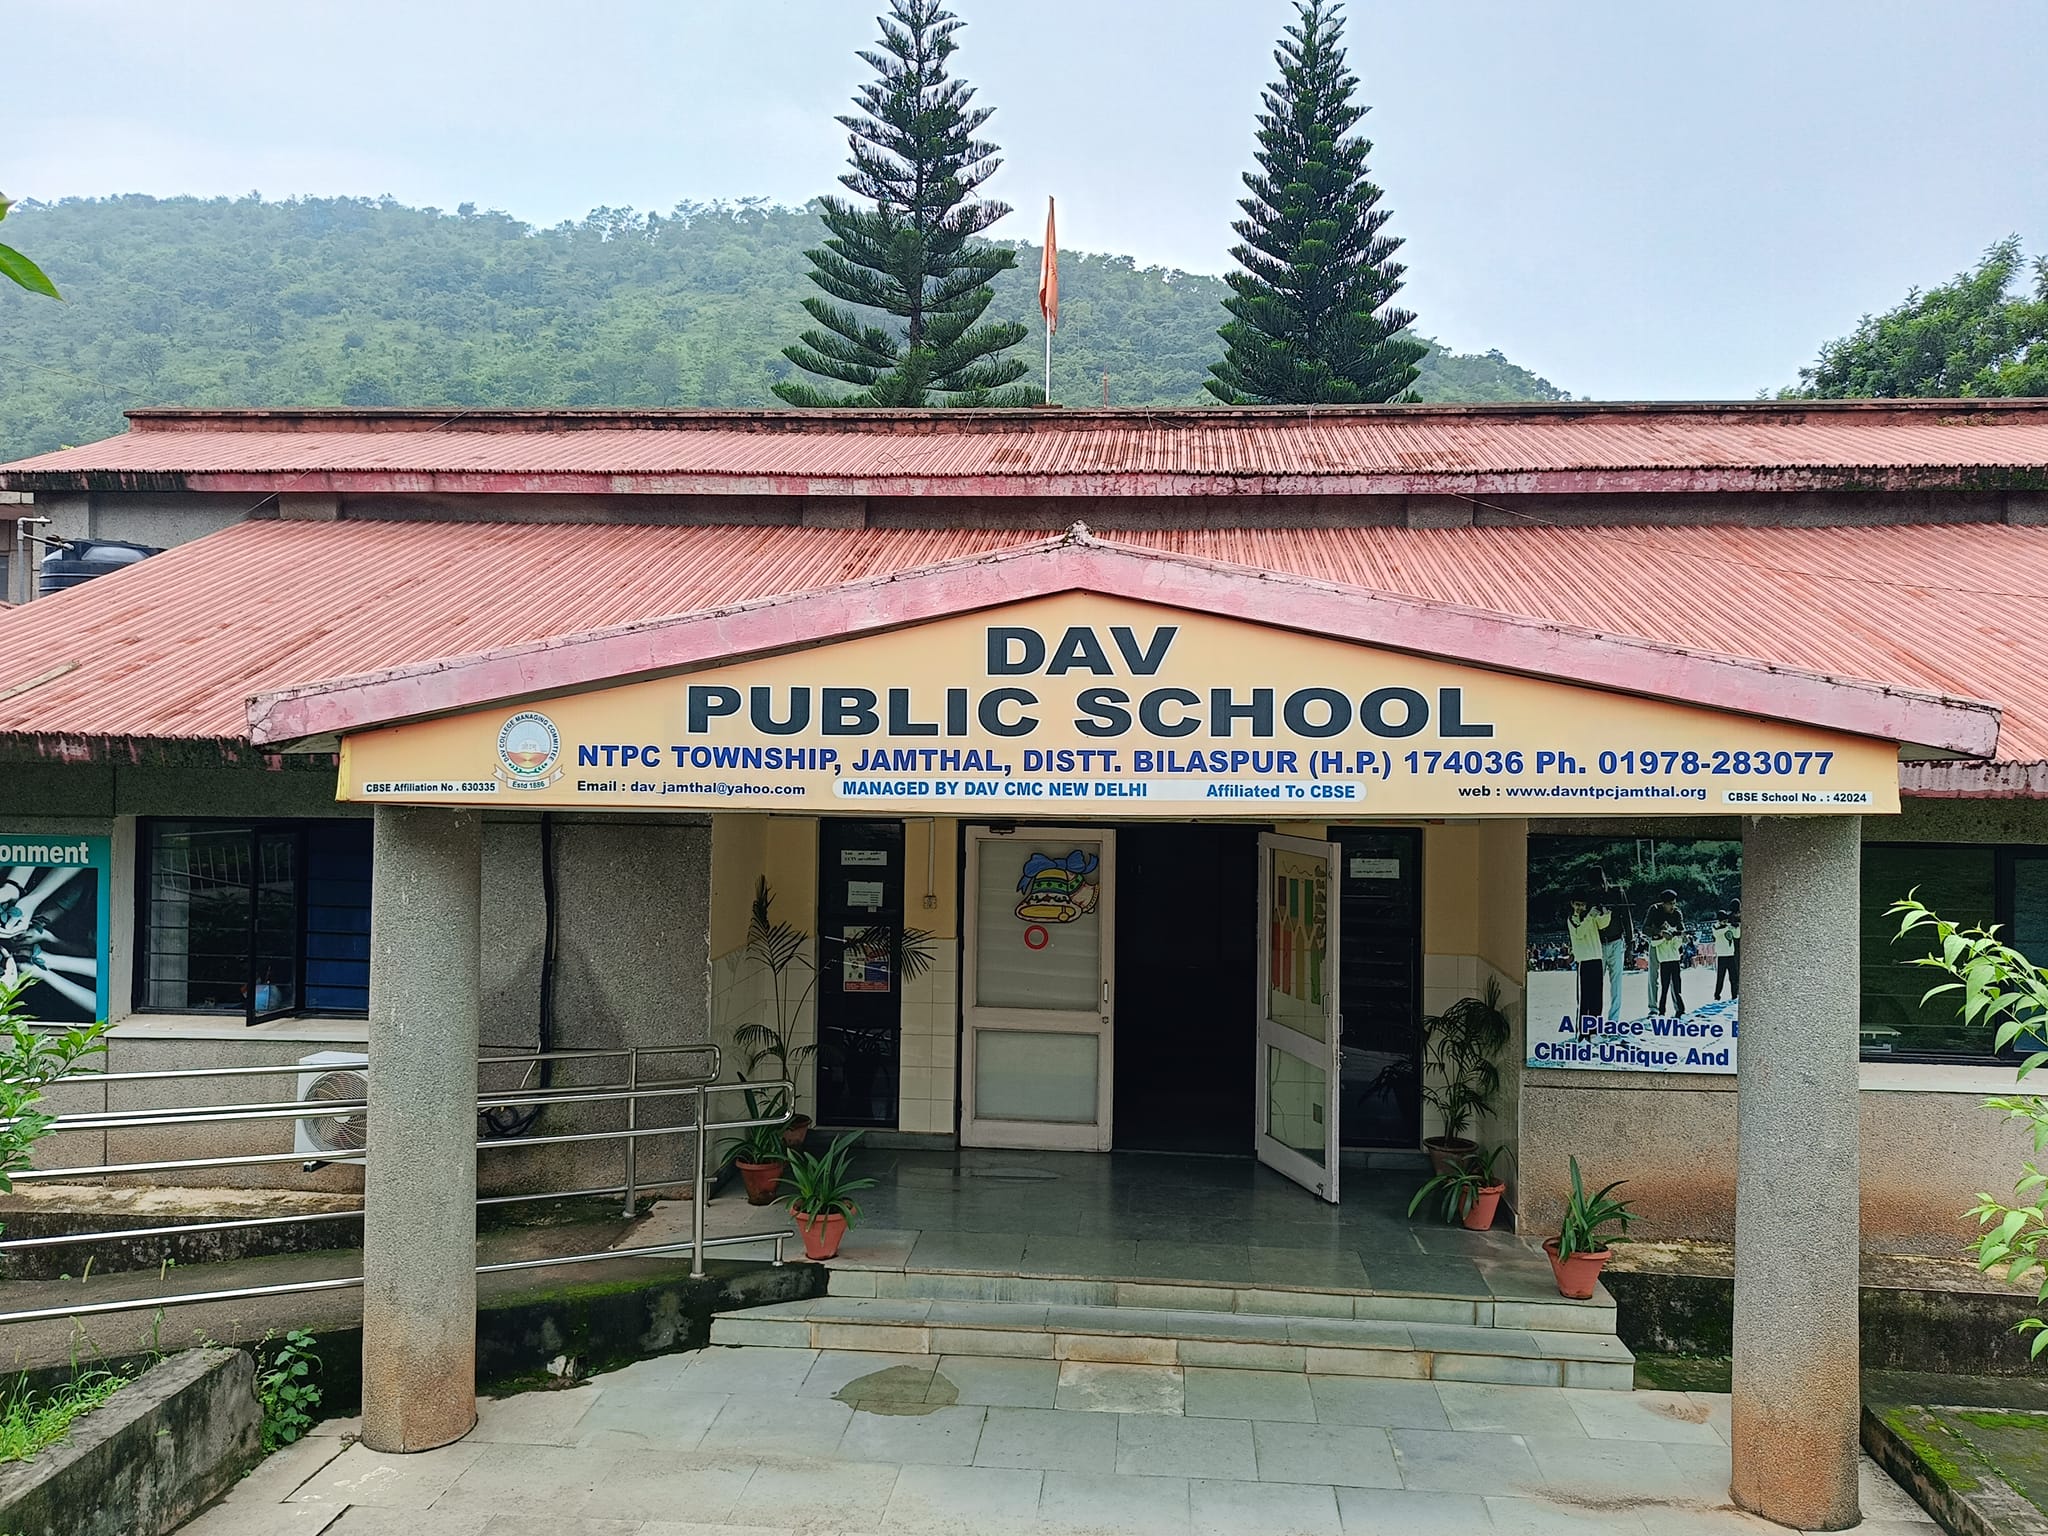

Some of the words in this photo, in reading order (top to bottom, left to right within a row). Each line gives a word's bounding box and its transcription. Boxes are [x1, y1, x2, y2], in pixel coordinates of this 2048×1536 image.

[987, 626, 1179, 676] DAV
[514, 713, 549, 726] MANAGING
[687, 685, 1041, 737] PUBLIC
[1073, 687, 1495, 738] SCHOOL
[499, 720, 516, 748] COLLEGE
[547, 724, 559, 762] COMMITTEE
[501, 749, 509, 763] DAV
[578, 745, 661, 768] NTPC
[671, 746, 841, 776] TOWNSHIP,
[852, 749, 1012, 777] JAMTHAL,
[1023, 749, 1121, 773] DISTT.
[1133, 750, 1298, 774] BILASPUR
[1309, 750, 1392, 780] (H.P.)
[1404, 750, 1524, 774] 174036
[1536, 751, 1587, 774] Ph.
[1599, 750, 1834, 775] 01978-283077
[366, 784, 391, 793] CBSE
[393, 783, 438, 792] Affiliation
[462, 782, 496, 792] 630335
[577, 780, 617, 792] Email
[630, 781, 806, 796] dav_jamthal@yahoo.com
[842, 781, 930, 796] MANAGED
[935, 781, 959, 796] BY
[964, 782, 999, 796] DAV
[1004, 782, 1043, 796] CMC
[1049, 782, 1089, 797] NEW
[1095, 783, 1147, 797] DELHI
[1206, 784, 1278, 798] Affiliated
[1288, 785, 1305, 798] To
[1310, 785, 1355, 798] CBSE
[1458, 786, 1491, 797] web
[1505, 786, 1707, 800] www.davntpcjamthal.org
[1728, 793, 1758, 802] CBSE
[1761, 793, 1798, 802] School
[1833, 793, 1867, 803] 42024
[0, 842, 88, 864] onment
[1558, 1015, 1574, 1033] A
[1582, 1016, 1644, 1036] Place
[1650, 1018, 1724, 1038] Where
[1534, 1042, 1592, 1061] Child
[1599, 1045, 1678, 1067] Unique
[1684, 1048, 1729, 1066] And
